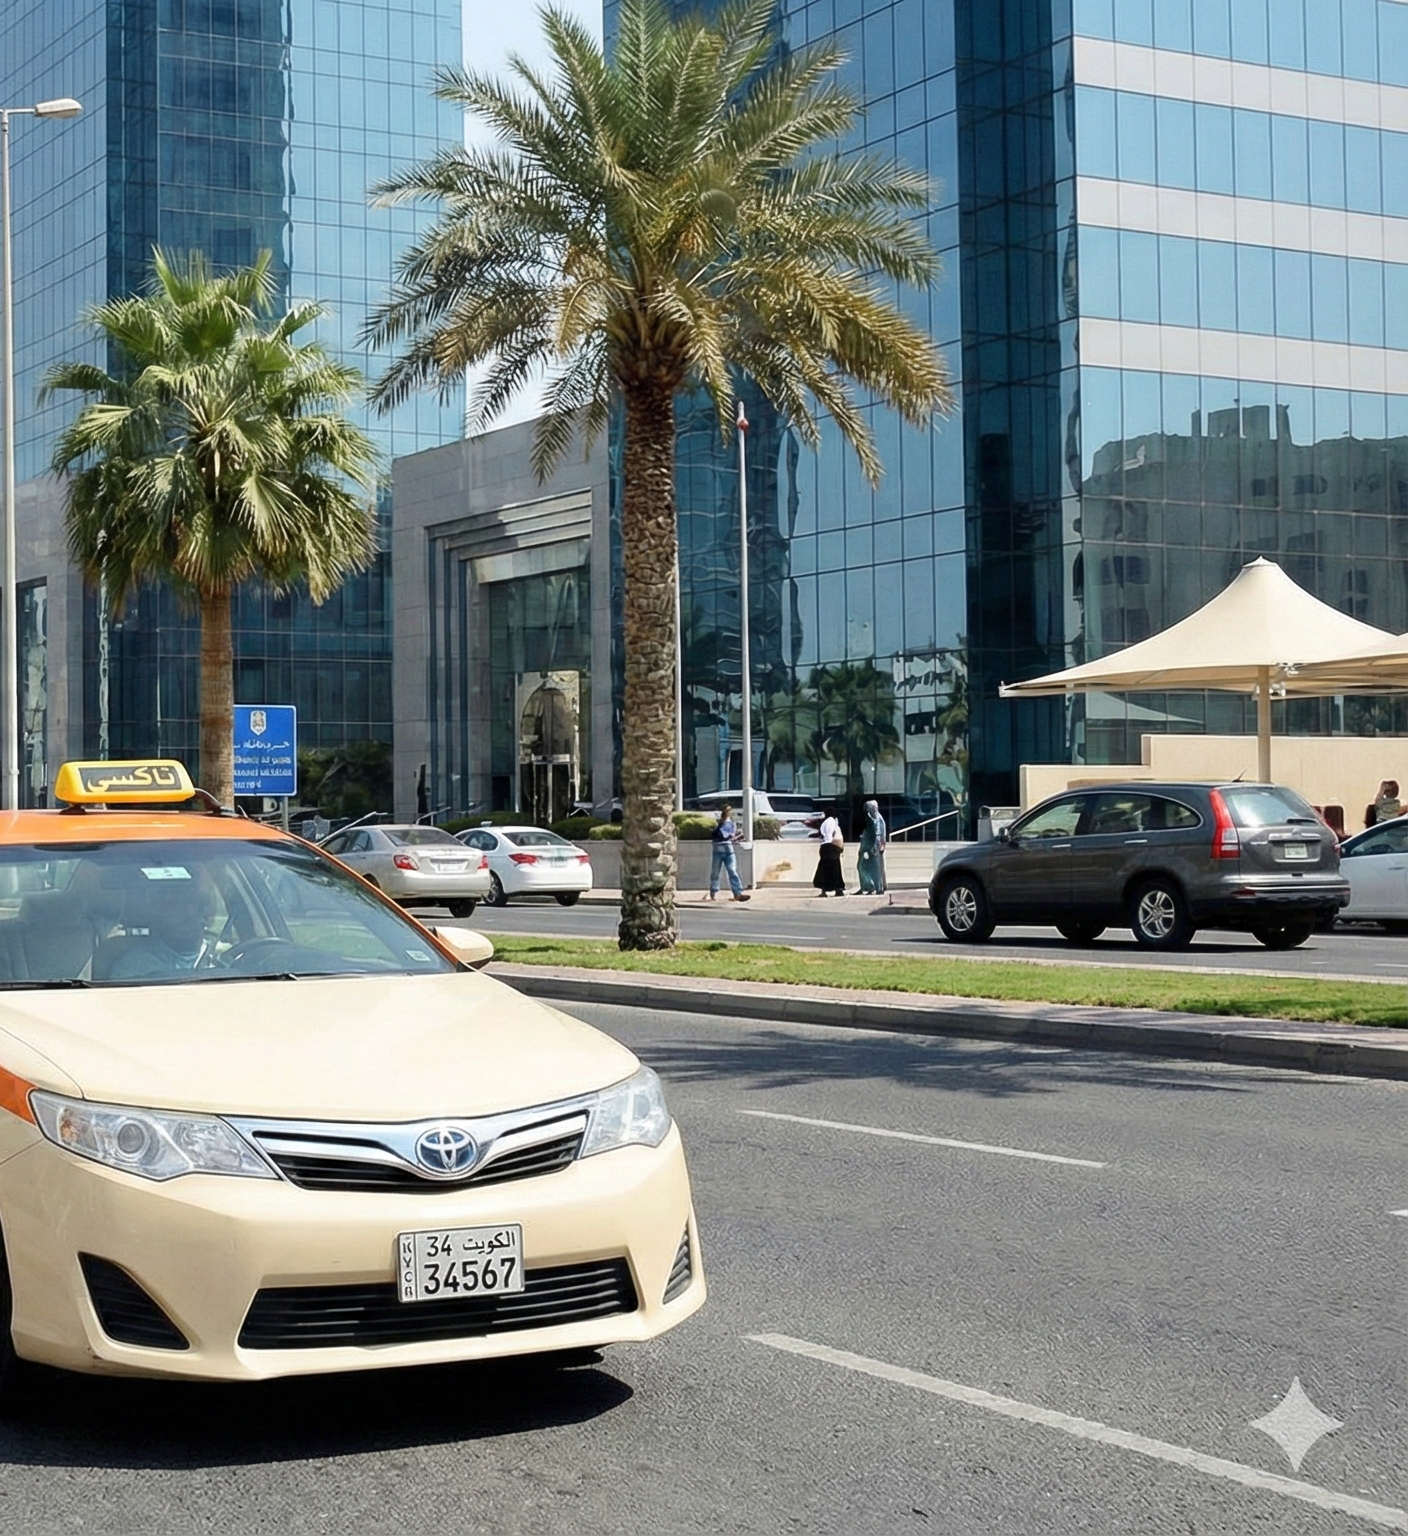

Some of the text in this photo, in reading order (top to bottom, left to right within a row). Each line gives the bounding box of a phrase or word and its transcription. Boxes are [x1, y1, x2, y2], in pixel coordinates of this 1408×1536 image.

[426, 1230, 516, 1258] 34 الكويت
[423, 1256, 517, 1295] 34567
